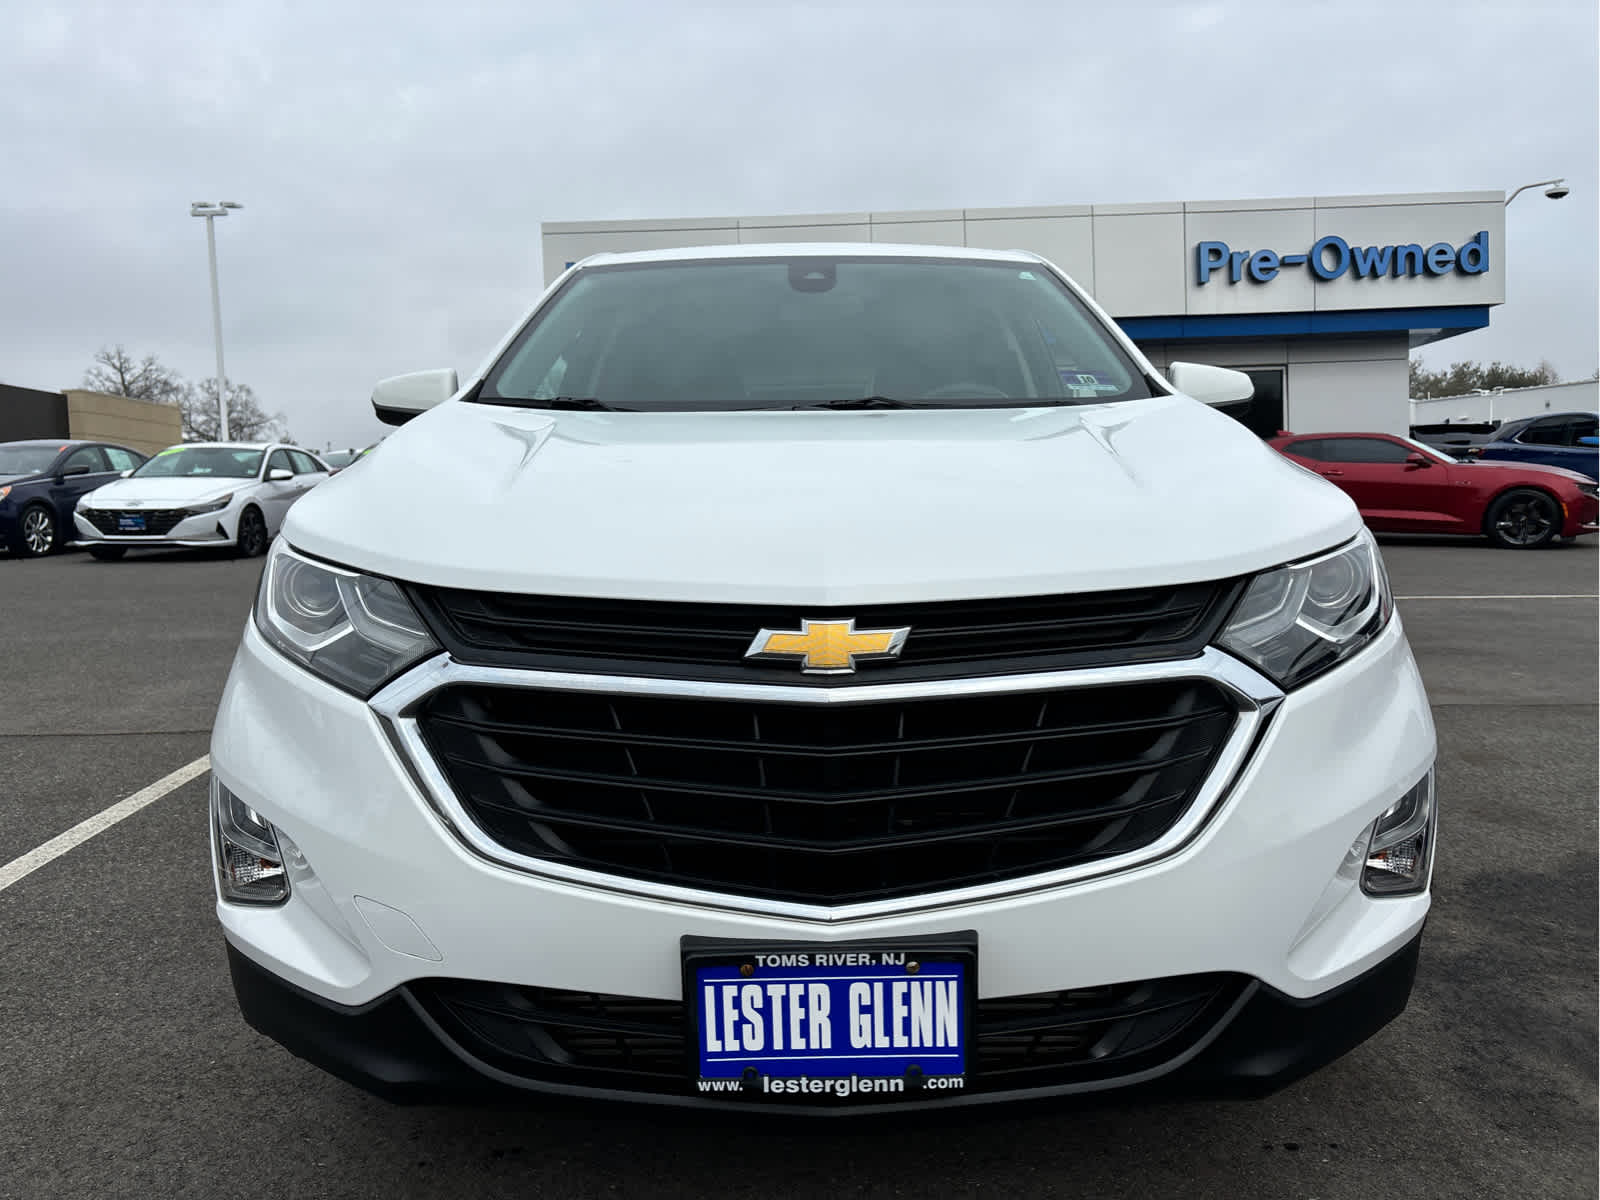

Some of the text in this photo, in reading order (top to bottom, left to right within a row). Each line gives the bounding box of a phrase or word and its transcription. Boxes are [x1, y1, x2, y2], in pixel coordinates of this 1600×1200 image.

[1197, 230, 1489, 284] Pre-Owned
[755, 953, 906, 967] TOMS RIVER, NJ
[704, 980, 958, 1052] LESTER GLENN
[698, 1076, 964, 1097] www. lesterglenn .com
